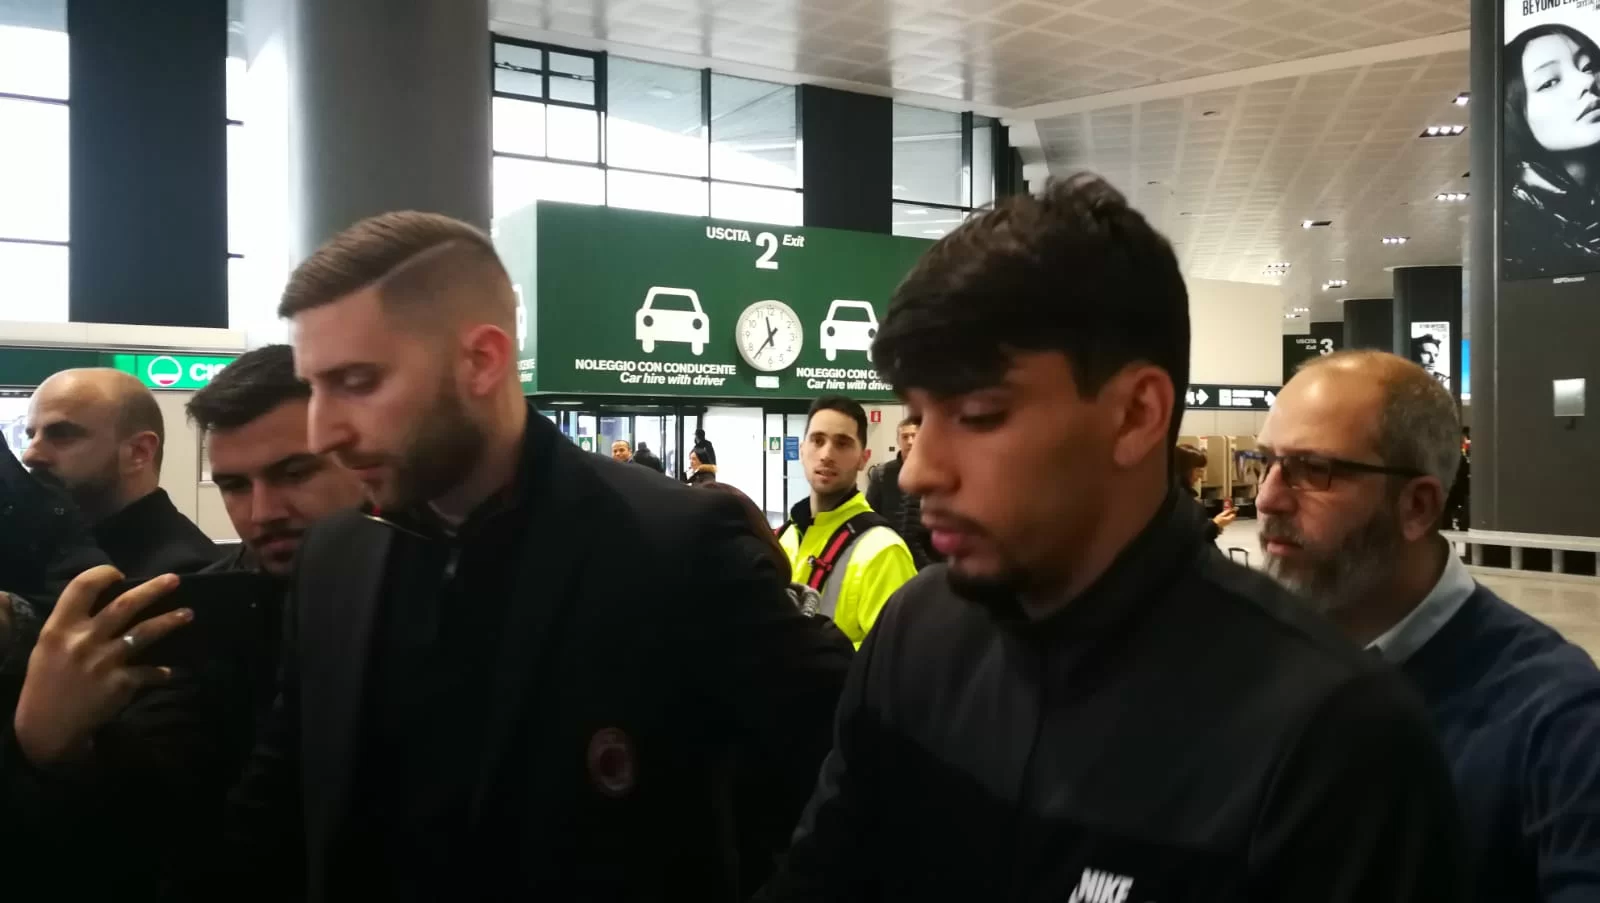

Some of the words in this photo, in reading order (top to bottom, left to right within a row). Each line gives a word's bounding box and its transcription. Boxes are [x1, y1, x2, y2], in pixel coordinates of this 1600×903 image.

[706, 226, 751, 243] USCITA
[755, 231, 779, 270] 2
[782, 234, 805, 248] Exit
[1319, 337, 1334, 356] 3
[575, 359, 636, 372] NOLEGGIO
[637, 361, 662, 373] CON
[663, 362, 737, 375] CONDUCENTE
[796, 367, 846, 378] NOLEGGIO
[847, 369, 868, 379] CON
[620, 372, 642, 384] Car
[643, 372, 666, 384] hire
[667, 373, 691, 385] with
[692, 374, 726, 386] driver
[807, 378, 825, 389] Car
[826, 378, 845, 389] hire
[846, 379, 867, 390] with
[1078, 866, 1135, 903] NIKE
